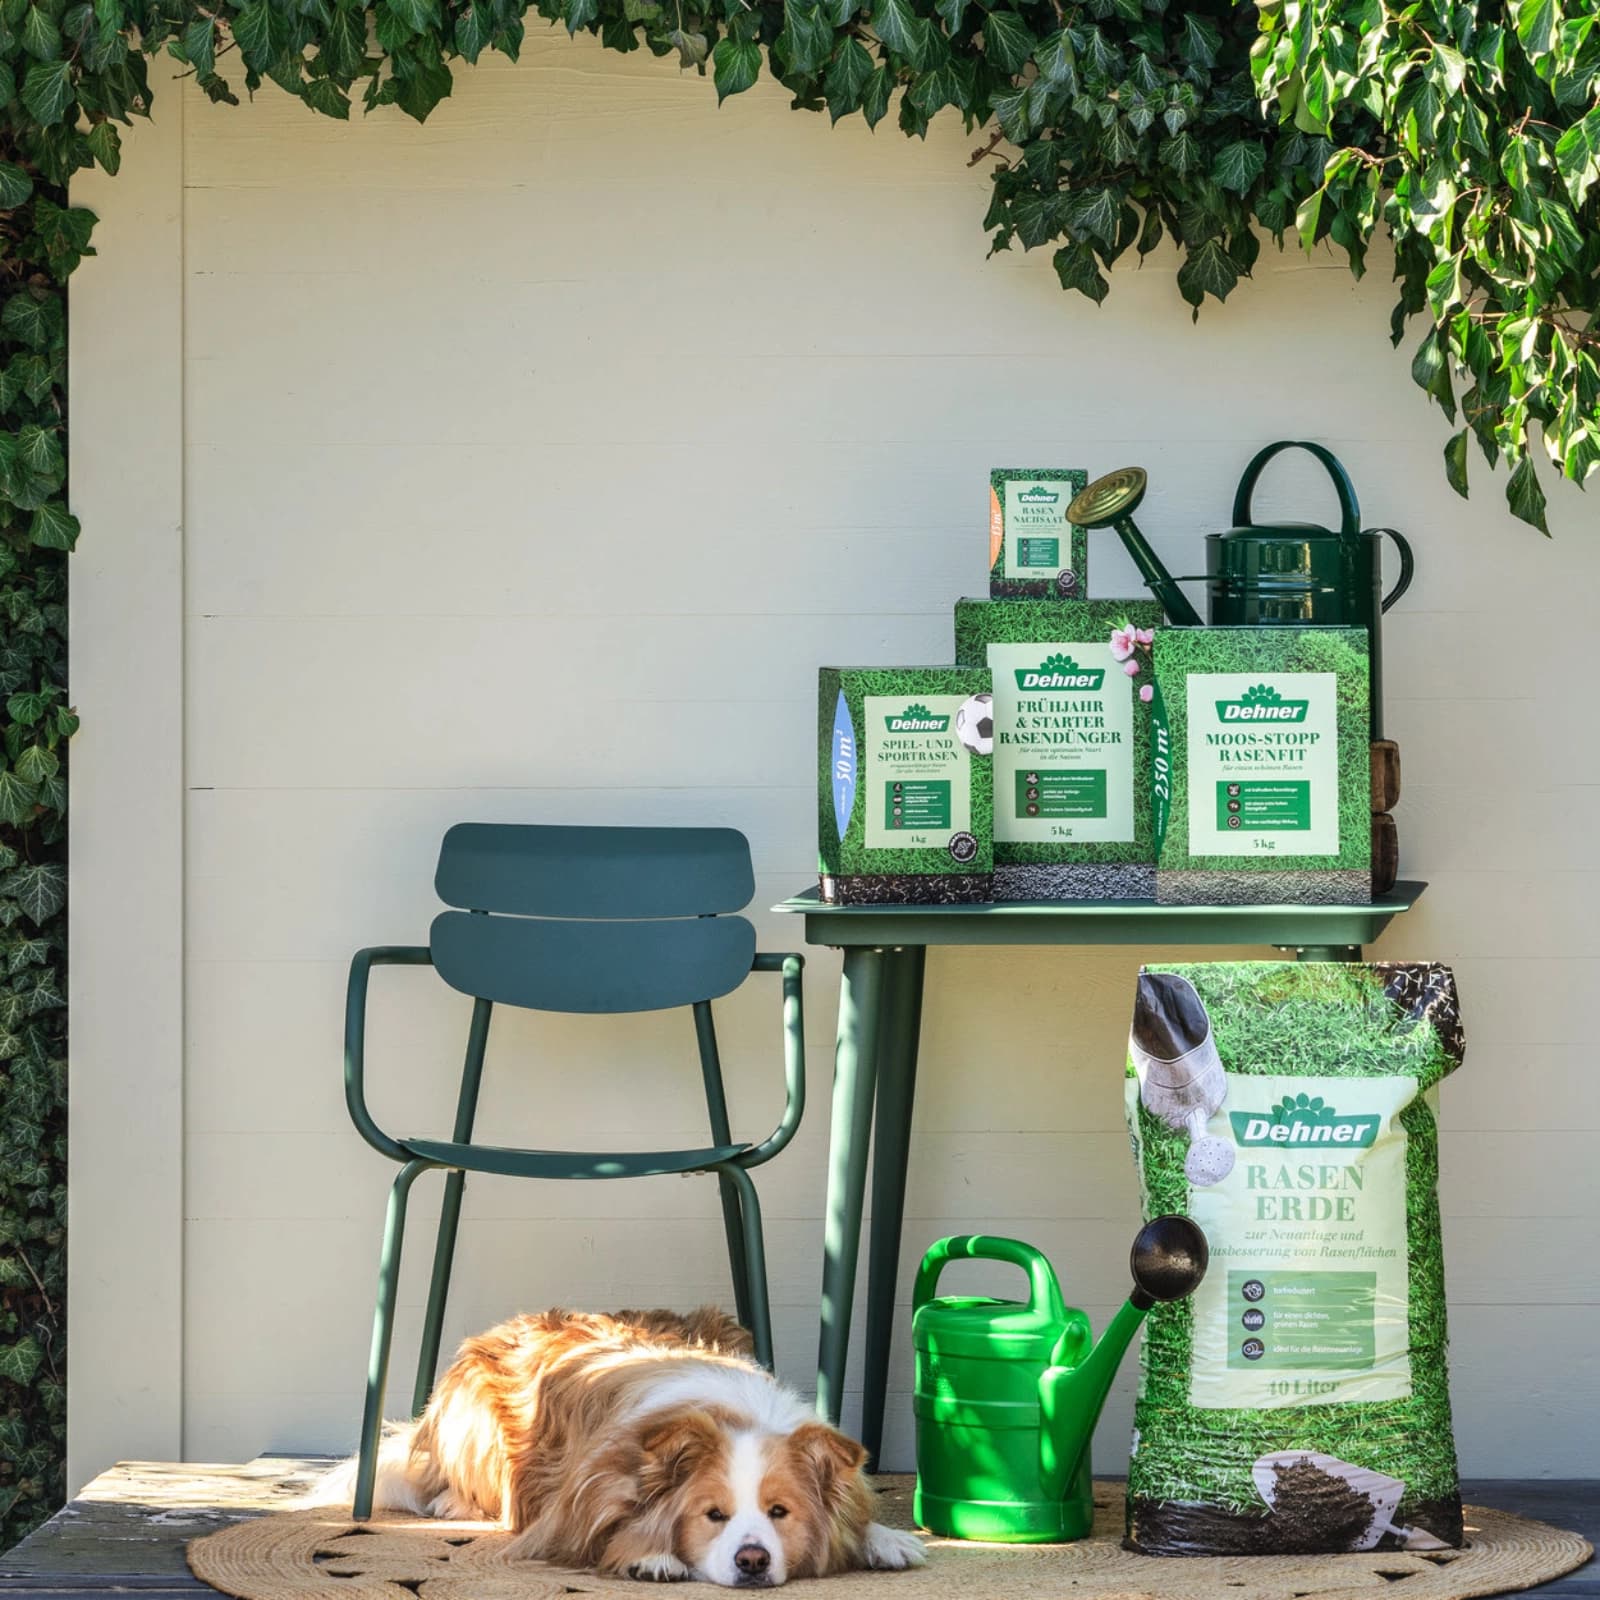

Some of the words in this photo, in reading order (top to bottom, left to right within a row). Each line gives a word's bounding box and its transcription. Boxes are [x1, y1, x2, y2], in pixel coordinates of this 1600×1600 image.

[1021, 492, 1057, 502] Dehner
[1022, 507, 1055, 515] RASEN
[1014, 516, 1064, 524] NACHSAAT
[1022, 672, 1099, 688] Dehner
[1017, 698, 1104, 713] FRÜHJAHR
[1223, 704, 1303, 720] Dehner
[889, 718, 946, 731] Dehner
[1016, 717, 1027, 728] &
[1032, 717, 1105, 728] STARTER
[1000, 729, 1122, 744] RASENDÜNGER
[1206, 732, 1320, 746] MOOS-STOPP
[882, 740, 923, 750] SPIEL-
[926, 739, 953, 749] UND
[878, 751, 959, 762] SPORTRASEN
[1219, 748, 1307, 761] RASENFIT
[836, 760, 852, 784] 50
[1154, 757, 1169, 800] 250
[1051, 826, 1057, 836] 5
[1059, 826, 1073, 836] kg
[1253, 839, 1259, 848] 5
[1261, 839, 1275, 849] kg
[1243, 1119, 1371, 1143] Dehner
[1246, 1164, 1365, 1191] RASEN
[1255, 1195, 1356, 1222] ERDE
[1244, 1230, 1267, 1240] zur
[1340, 1229, 1365, 1240] und
[1293, 1248, 1317, 1258] von
[1320, 1245, 1397, 1260] Rasenflächen
[1292, 1378, 1341, 1396] Liter
